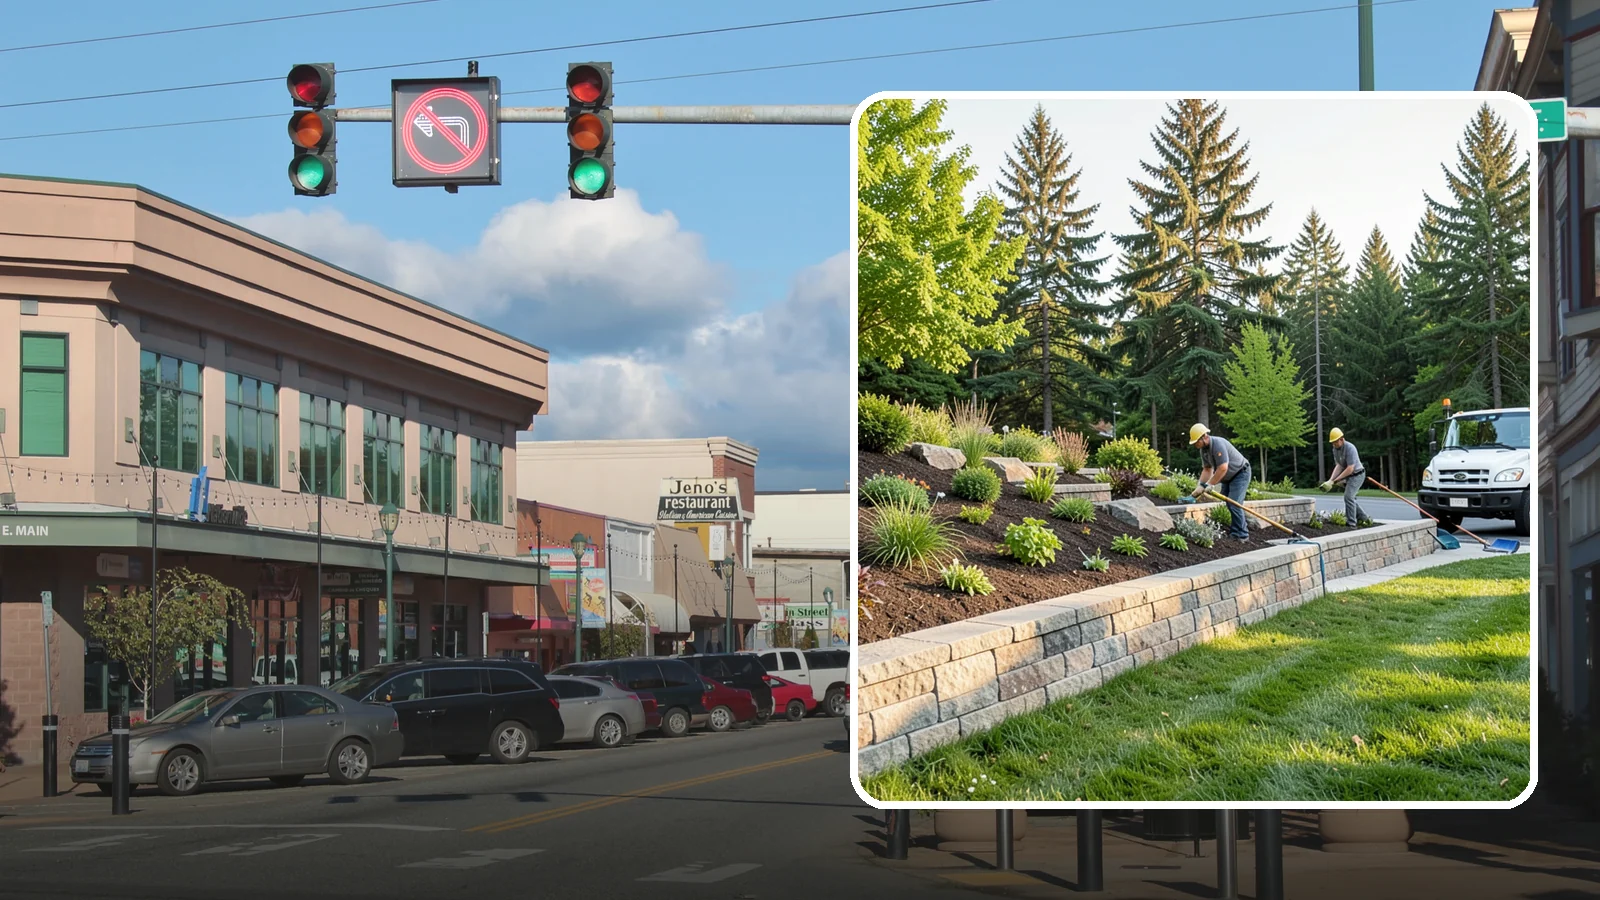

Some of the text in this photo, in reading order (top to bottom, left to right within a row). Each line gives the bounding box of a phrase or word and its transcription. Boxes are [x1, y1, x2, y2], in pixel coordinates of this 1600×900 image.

[670, 480, 727, 494] Jeno's
[665, 496, 731, 509] restaurant
[659, 510, 681, 519] Italian
[686, 510, 714, 519] American
[715, 509, 737, 519] Cuisine
[2, 525, 49, 536] E. MAIN
[797, 607, 828, 617] Street
